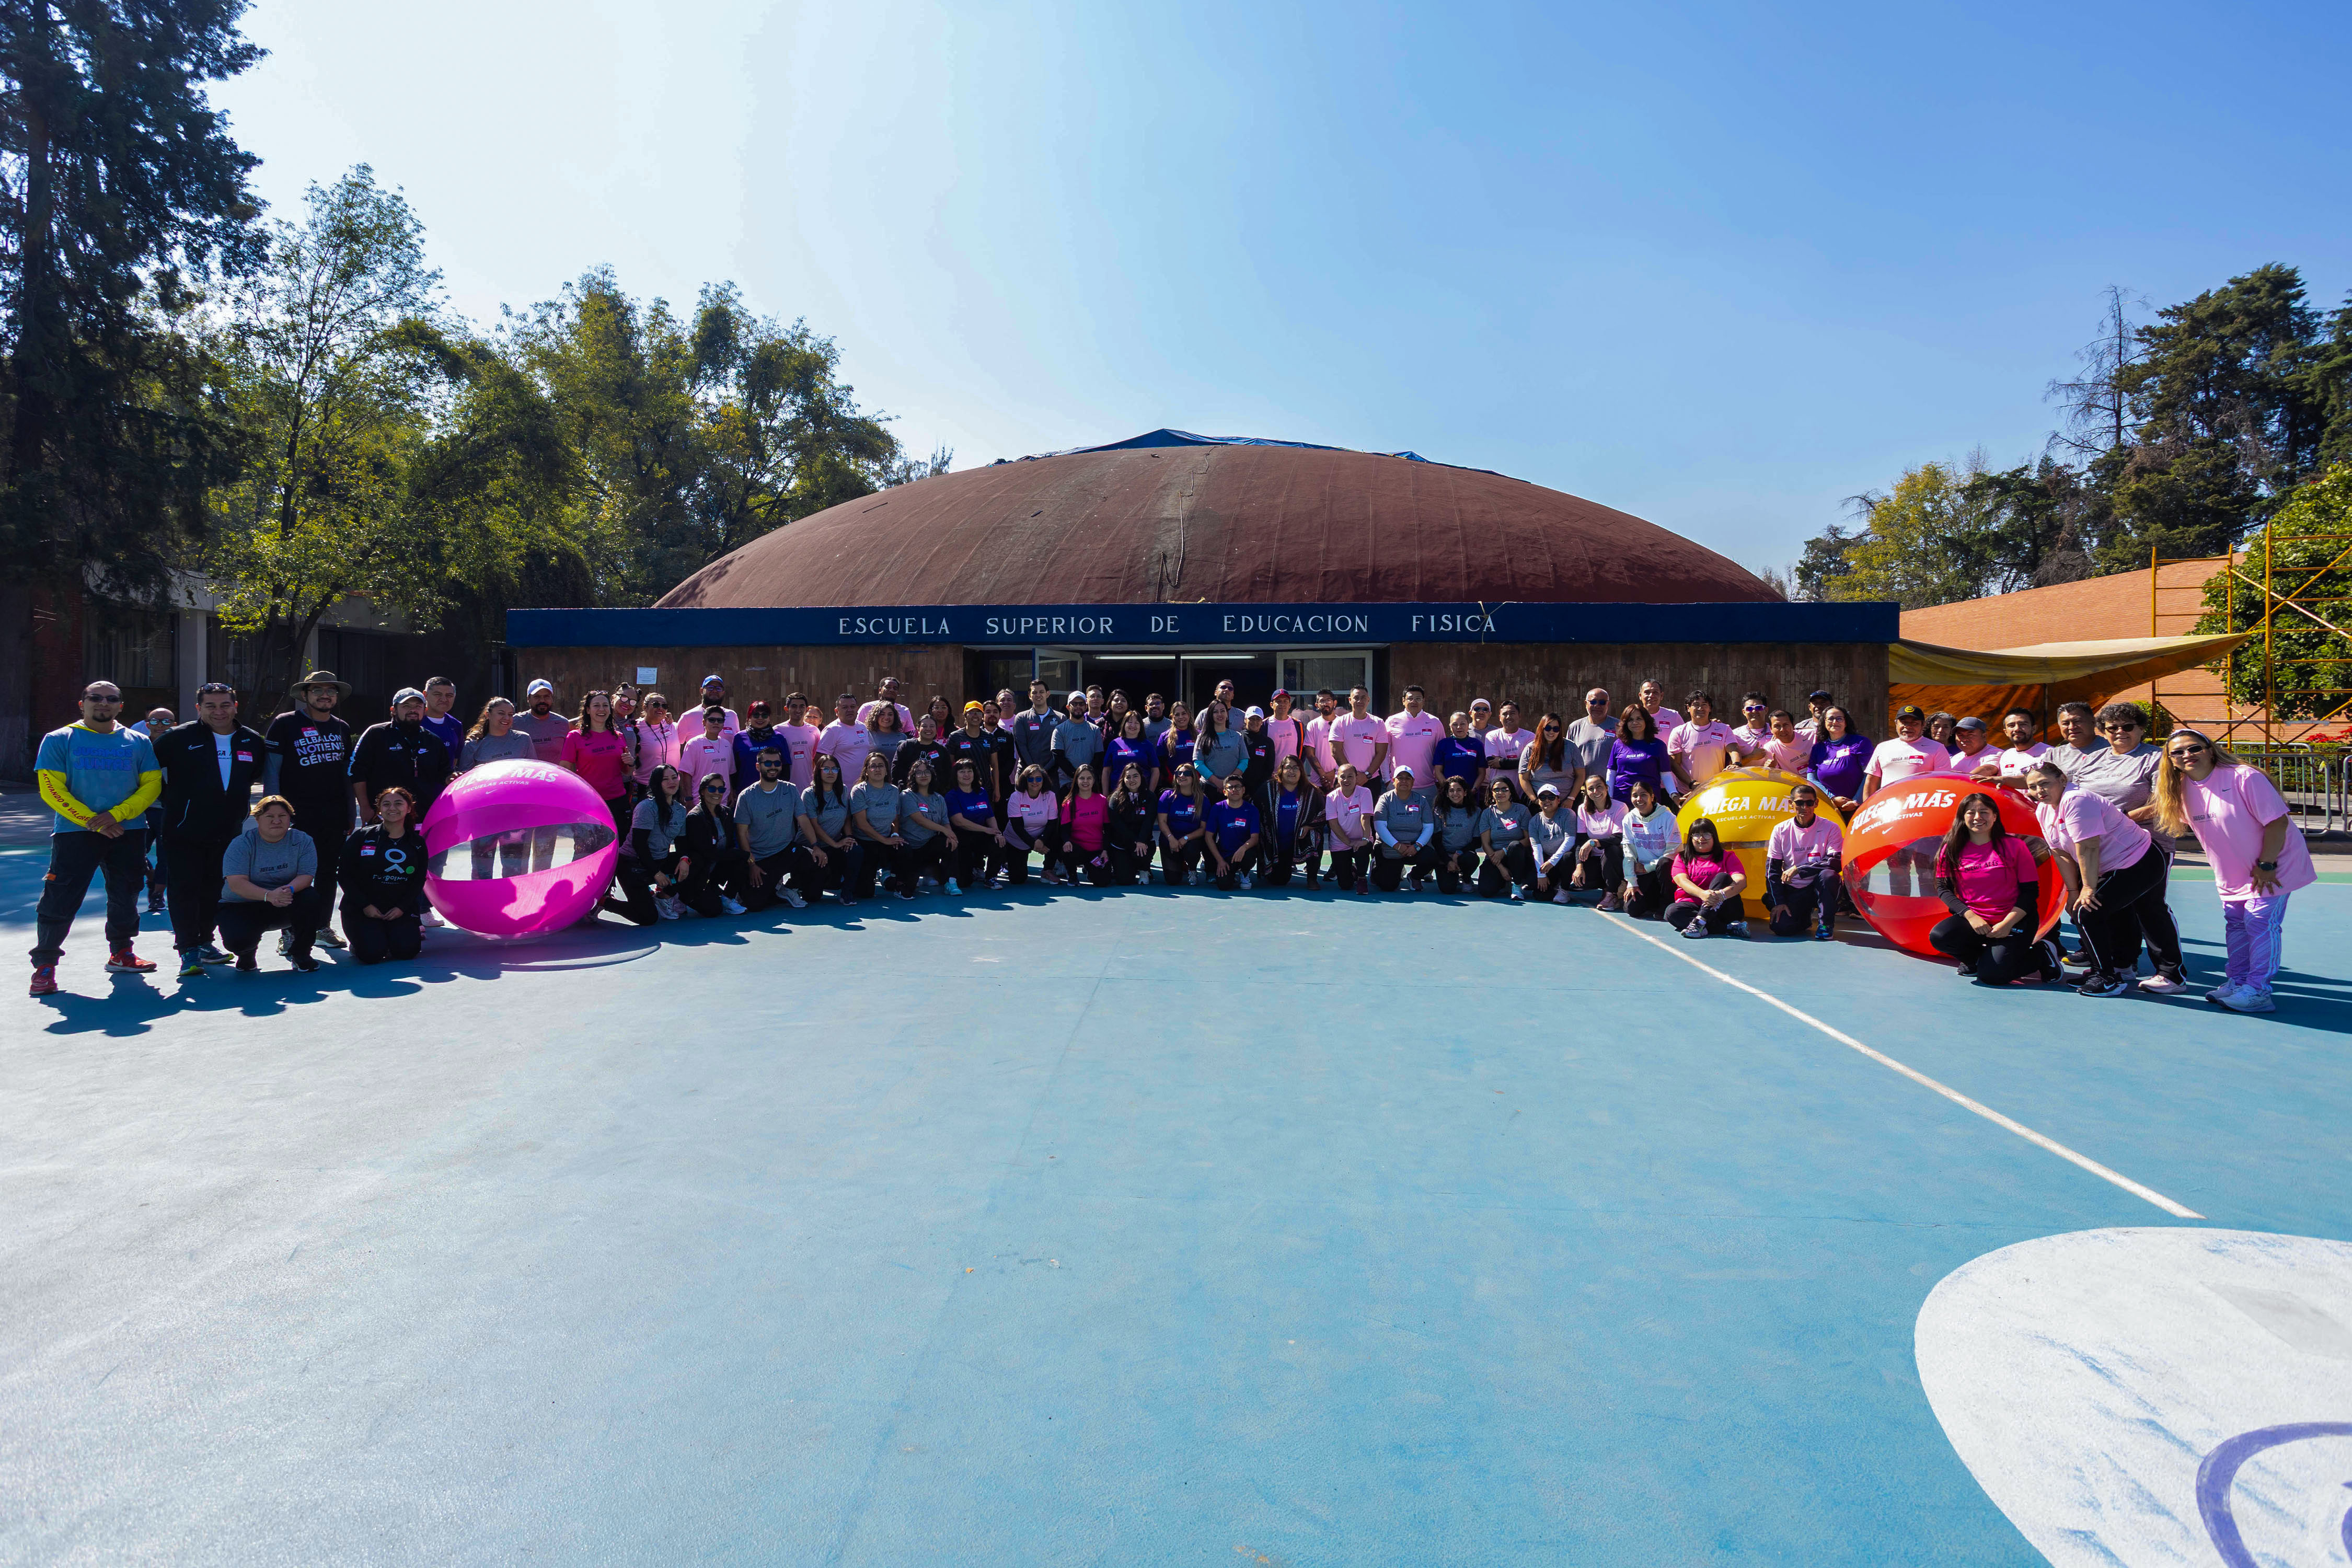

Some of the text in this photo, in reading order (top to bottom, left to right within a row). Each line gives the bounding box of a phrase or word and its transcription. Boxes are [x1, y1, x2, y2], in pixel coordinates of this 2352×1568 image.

[839, 614, 1496, 634] ESCUELA SUPERIOR DE EDUCACION FISICA
[293, 733, 341, 747] #ELBALÓN
[73, 747, 133, 757] JUGAMOS
[296, 742, 344, 756] NOTIENE
[73, 758, 132, 771] JUNTAS
[510, 768, 559, 782] MÁS
[42, 773, 64, 802] ACTIVANDO
[463, 781, 497, 794] ESCUELAS
[1702, 797, 1749, 816] JUEGA
[1903, 790, 1956, 810] MÁS
